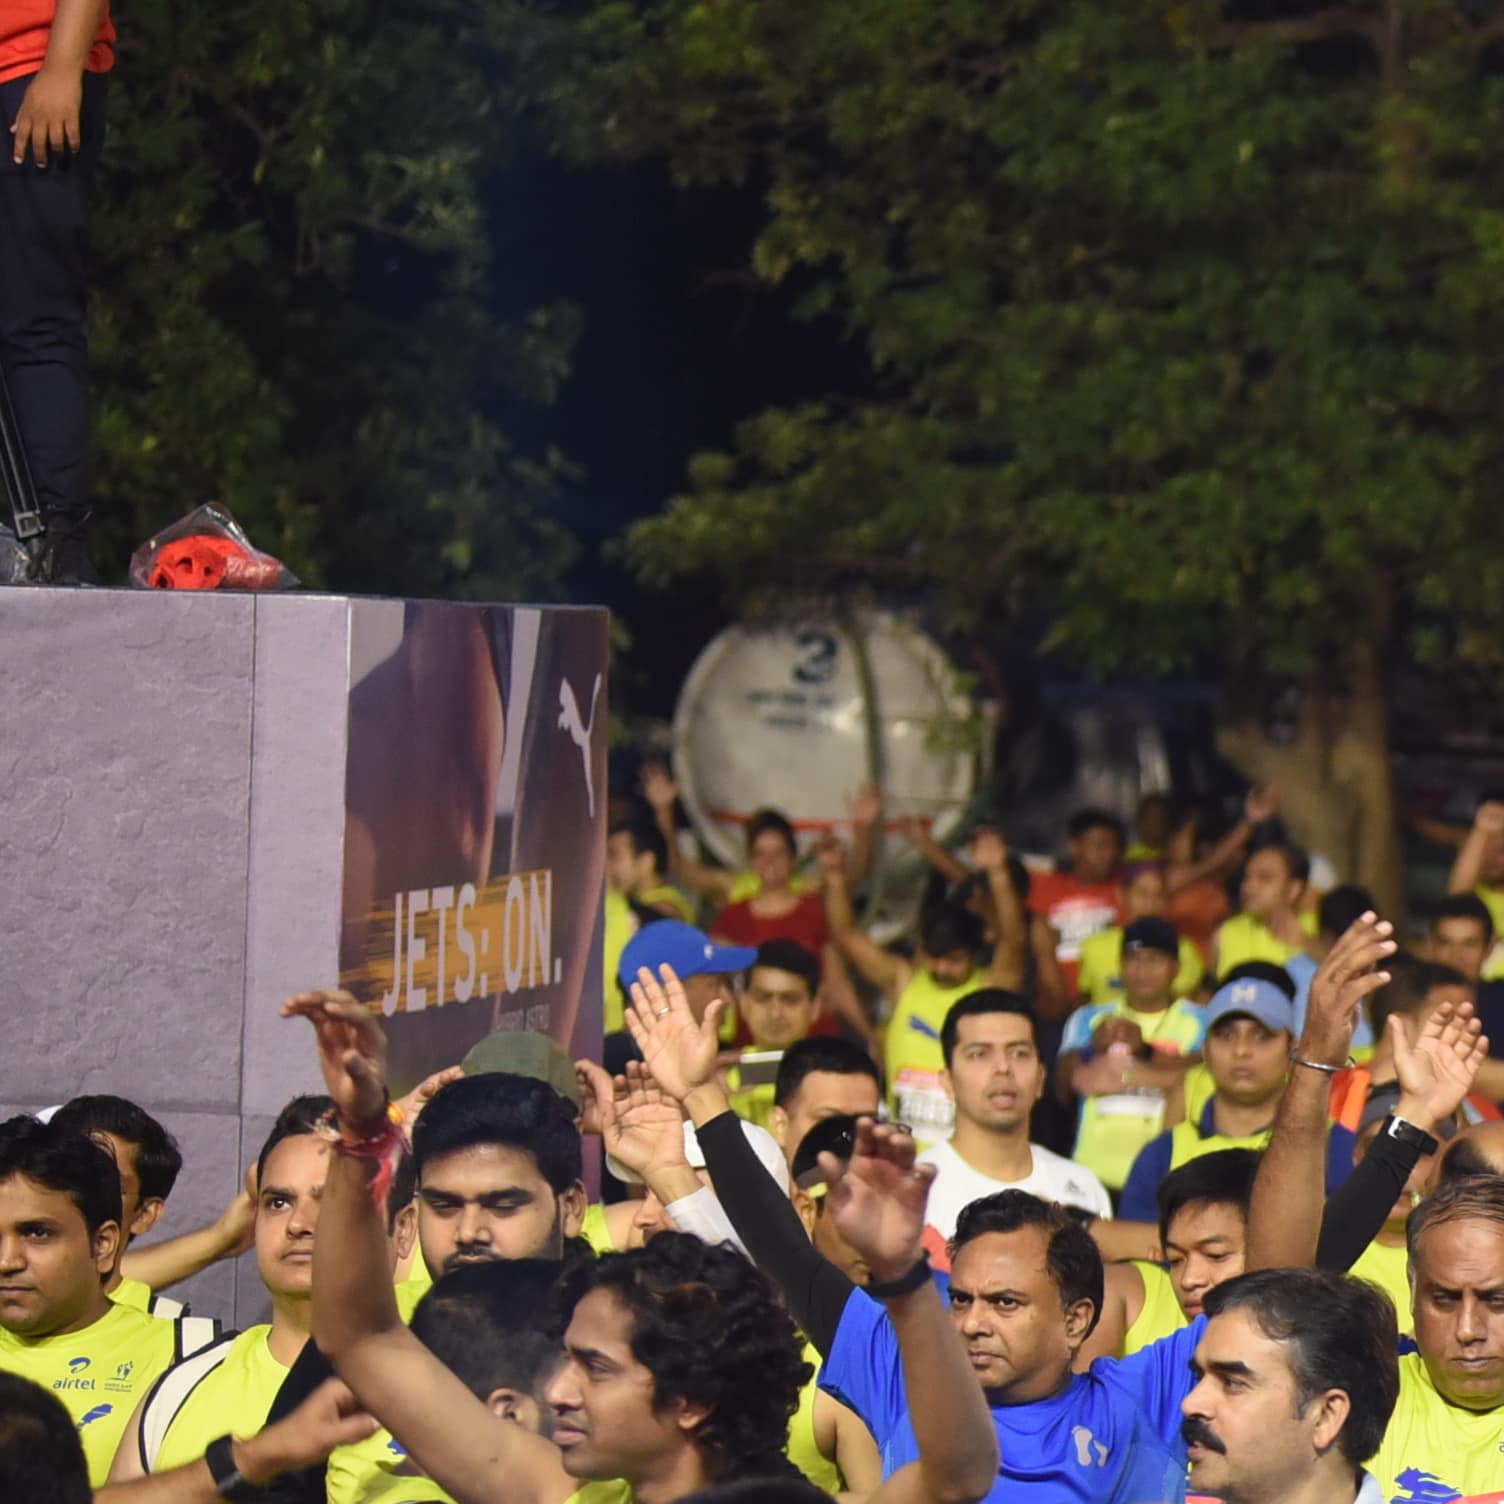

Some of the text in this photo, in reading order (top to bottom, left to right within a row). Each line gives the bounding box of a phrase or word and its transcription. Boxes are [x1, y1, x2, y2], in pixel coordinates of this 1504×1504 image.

[381, 868, 563, 1018] JETS: ON.
[52, 1377, 97, 1390] airtel
